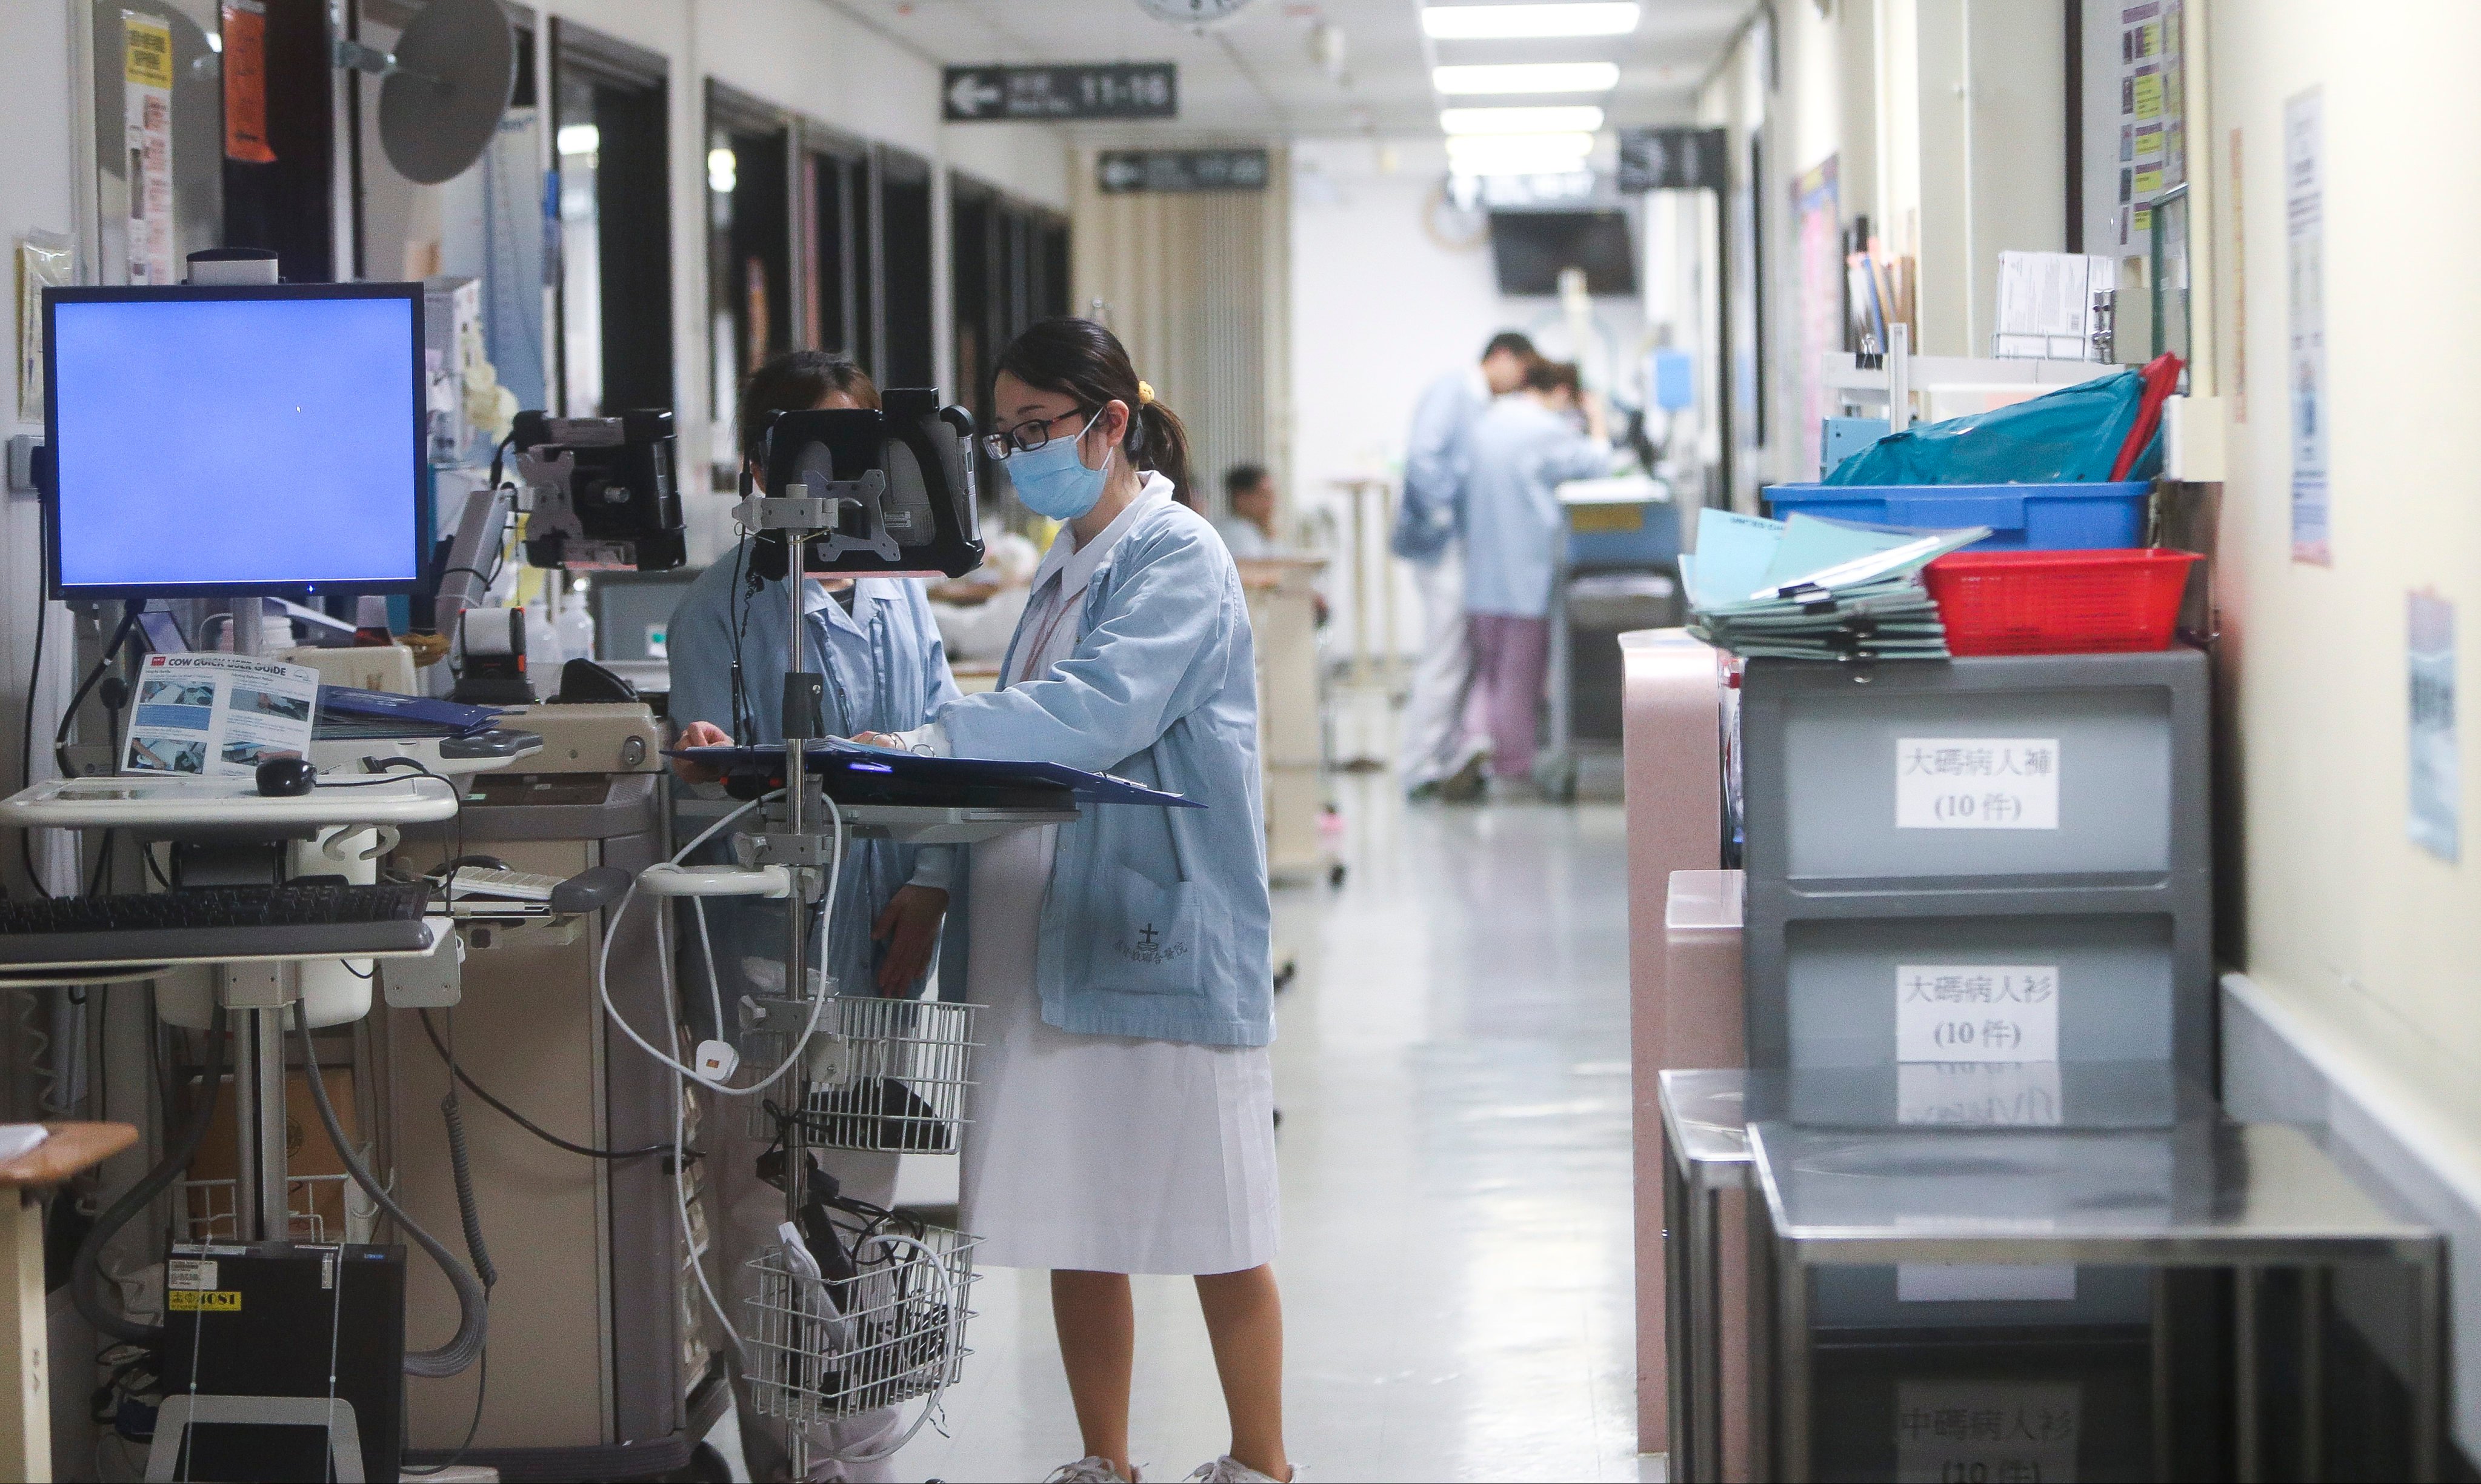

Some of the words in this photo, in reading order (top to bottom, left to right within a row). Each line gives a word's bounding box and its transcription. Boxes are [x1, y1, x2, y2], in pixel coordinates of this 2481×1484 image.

[168, 658, 192, 667] COW
[255, 662, 287, 676] GUIDE
[1934, 794, 1975, 822] (10
[1982, 793, 2023, 822] 件)
[1905, 975, 2053, 1003] 大碼病人衫
[1933, 1020, 1975, 1050] (10
[1982, 1019, 2022, 1050] 件)
